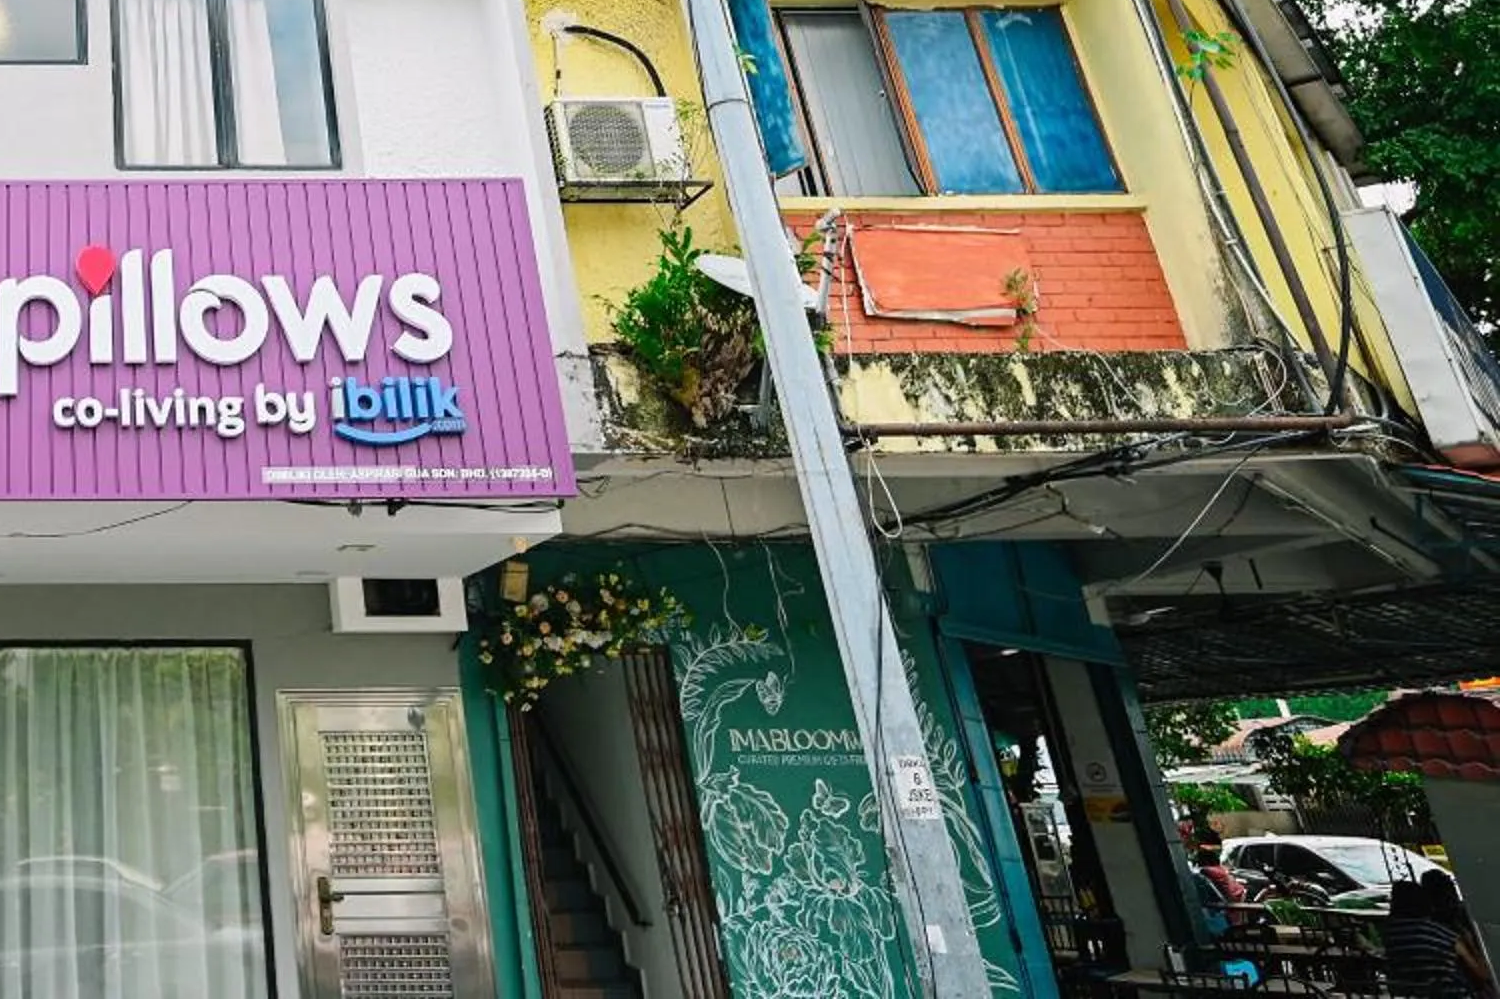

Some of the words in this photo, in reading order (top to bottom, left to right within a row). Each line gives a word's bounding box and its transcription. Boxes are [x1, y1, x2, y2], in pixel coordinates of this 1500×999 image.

[53, 386, 246, 438] co-living
[255, 383, 317, 434] by
[329, 376, 466, 420] ibilik
